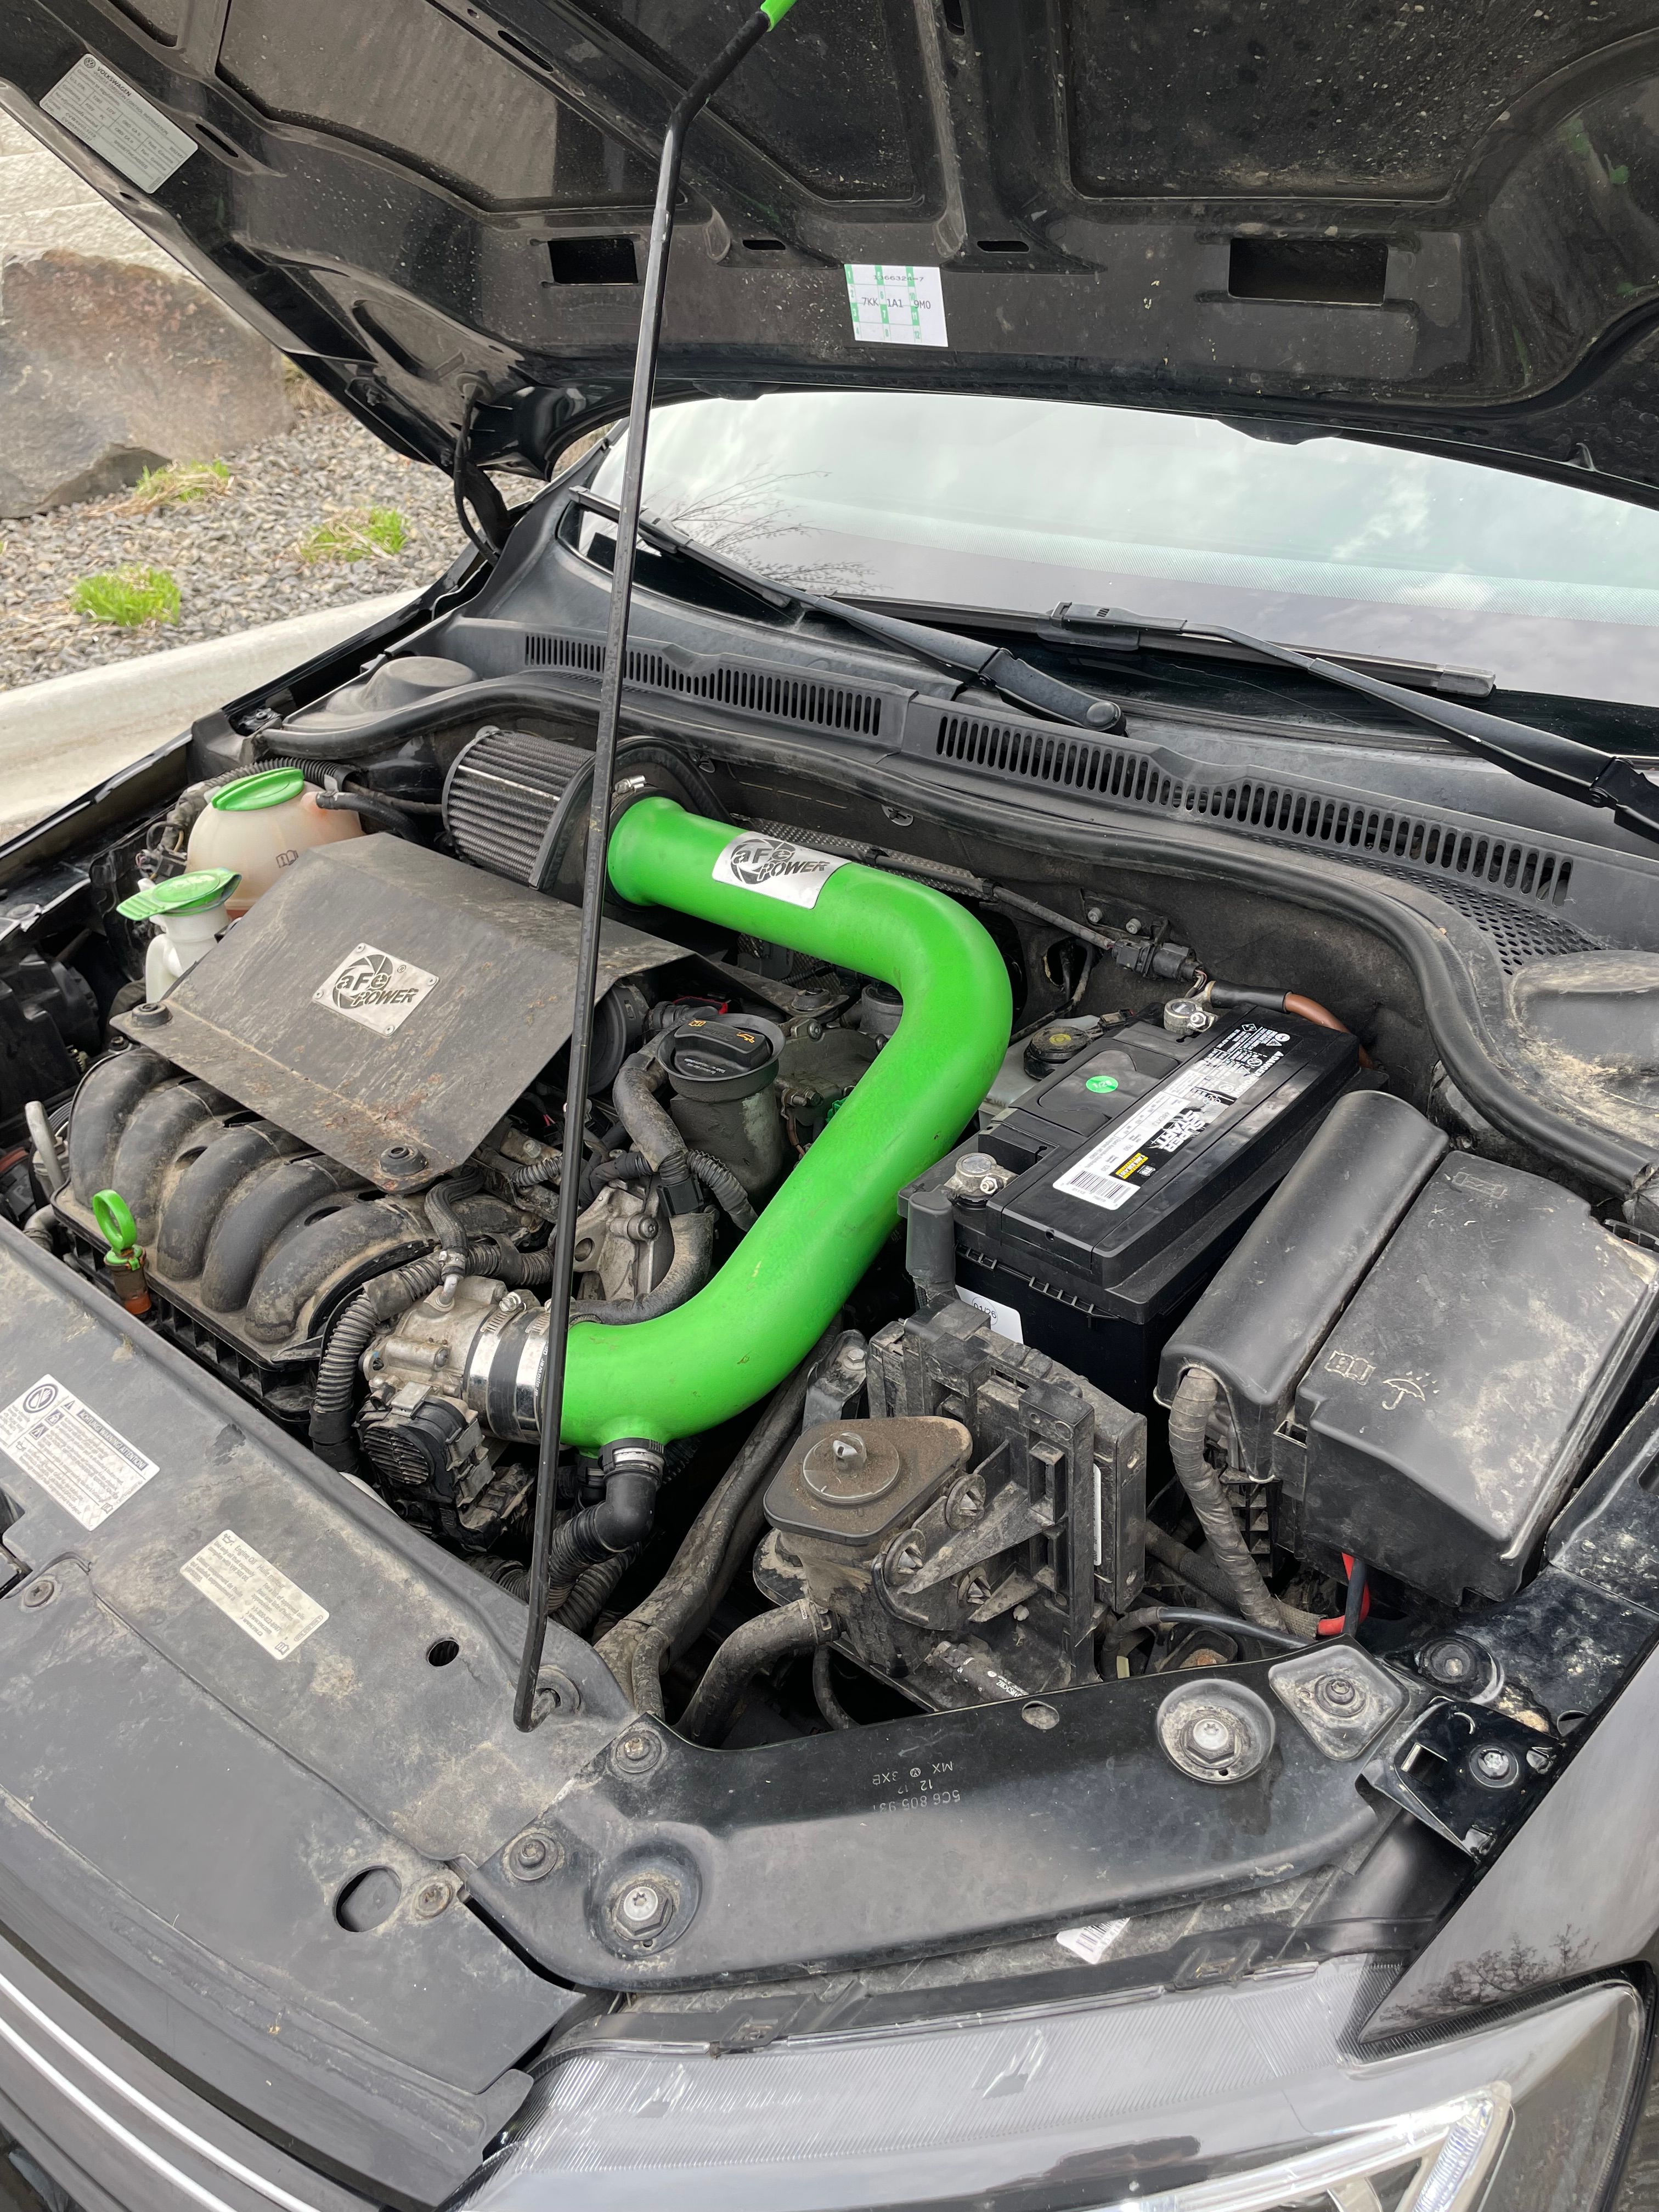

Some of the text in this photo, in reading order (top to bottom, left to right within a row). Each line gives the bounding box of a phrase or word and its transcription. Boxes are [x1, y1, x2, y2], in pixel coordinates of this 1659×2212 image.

[95, 66, 132, 97] VOLKSWAGEN
[861, 297, 879, 306] 7KK
[887, 298, 904, 308] 1A1
[732, 848, 795, 865] aFe
[757, 861, 830, 882] POWER
[336, 972, 391, 990] aFe
[351, 988, 420, 1007] POWER
[1148, 1109, 1203, 1150] START
[1161, 1118, 1207, 1153] SUPER
[78, 1410, 103, 1432] ACHTUNG!
[98, 1427, 123, 1449] WARNING!
[118, 1445, 146, 1470] ATTENTION!
[218, 1545, 229, 1556] only
[230, 1555, 241, 1564] that
[236, 1561, 256, 1578] expressly
[221, 1557, 232, 1567] with
[232, 1545, 286, 1590] Engine Oil Huile moteur
[256, 1588, 267, 1598] Pour
[270, 1600, 281, 1610] liste
[270, 1589, 280, 1598] list
[279, 1598, 300, 1615] approved
[932, 1760, 953, 1774] MX
[919, 1779, 933, 1791] 12
[902, 1795, 927, 1810] 805
[933, 1790, 961, 1805] 5C6
